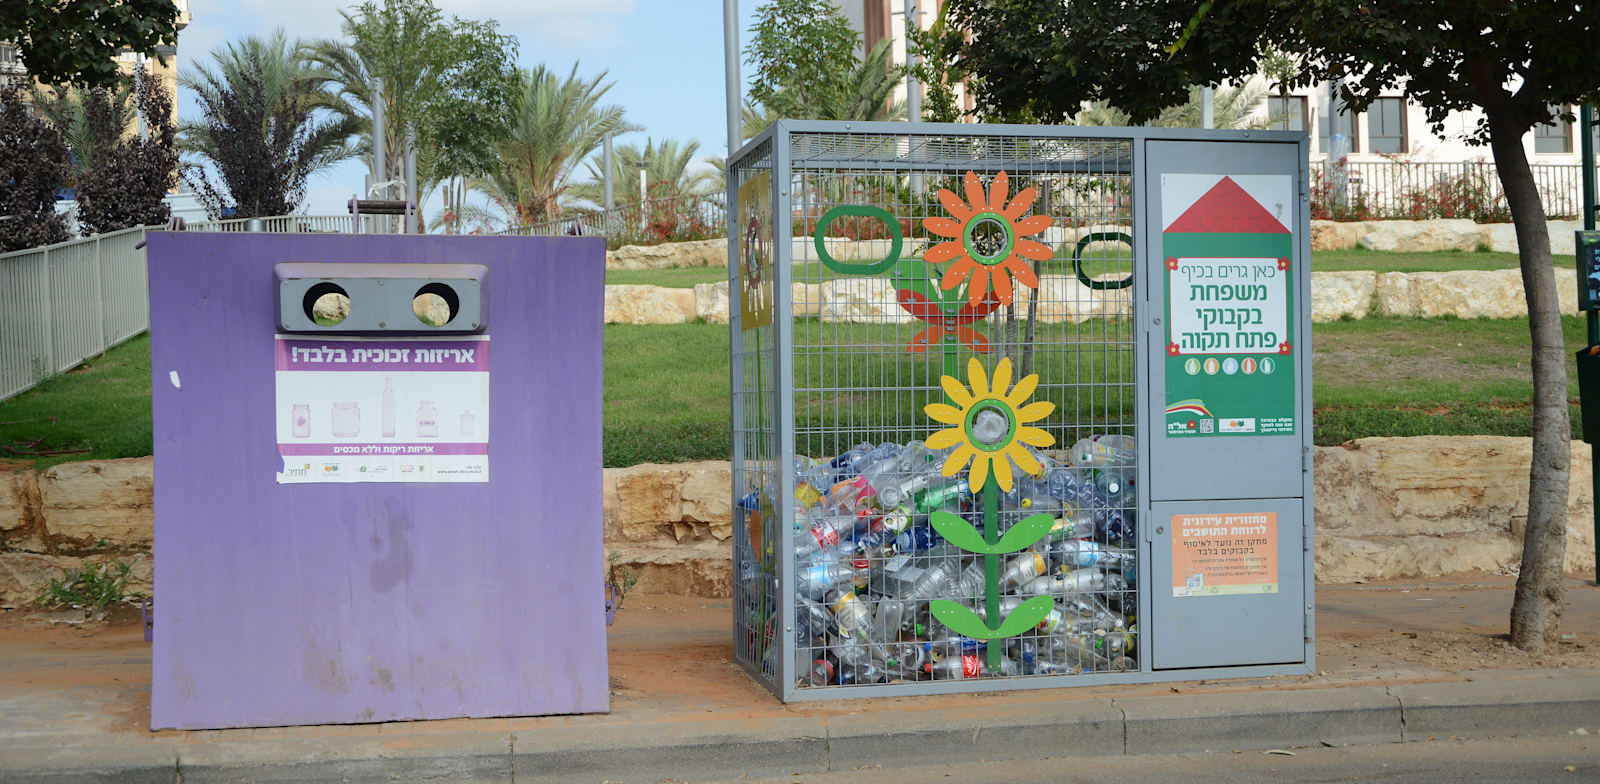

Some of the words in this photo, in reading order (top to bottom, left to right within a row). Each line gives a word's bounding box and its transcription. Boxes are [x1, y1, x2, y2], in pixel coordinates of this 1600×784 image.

[1181, 265, 1214, 283] בכיף
[1218, 265, 1248, 278] גרים
[1252, 265, 1276, 282] כאן
[1190, 284, 1268, 301] משפחת
[1195, 308, 1263, 331] בקבוקי
[1181, 331, 1231, 352] תקוה
[1235, 331, 1278, 349] פתח
[291, 345, 348, 364] בלבד!
[351, 348, 411, 364] זכוכית
[414, 348, 475, 364] אריזות
[333, 445, 360, 454] מכסים
[361, 444, 381, 454] וללא
[383, 445, 406, 455] ריקות
[407, 445, 434, 454] אריזות
[1183, 517, 1222, 526] עירונית
[1182, 527, 1227, 537] התושבים
[1230, 526, 1267, 536] לרווחת
[1183, 539, 1211, 549] לאיסוף
[1214, 539, 1232, 547] נועד
[1247, 538, 1268, 547] מתקן
[1197, 547, 1218, 555] בלבד
[1221, 547, 1255, 556] בקבוקים
